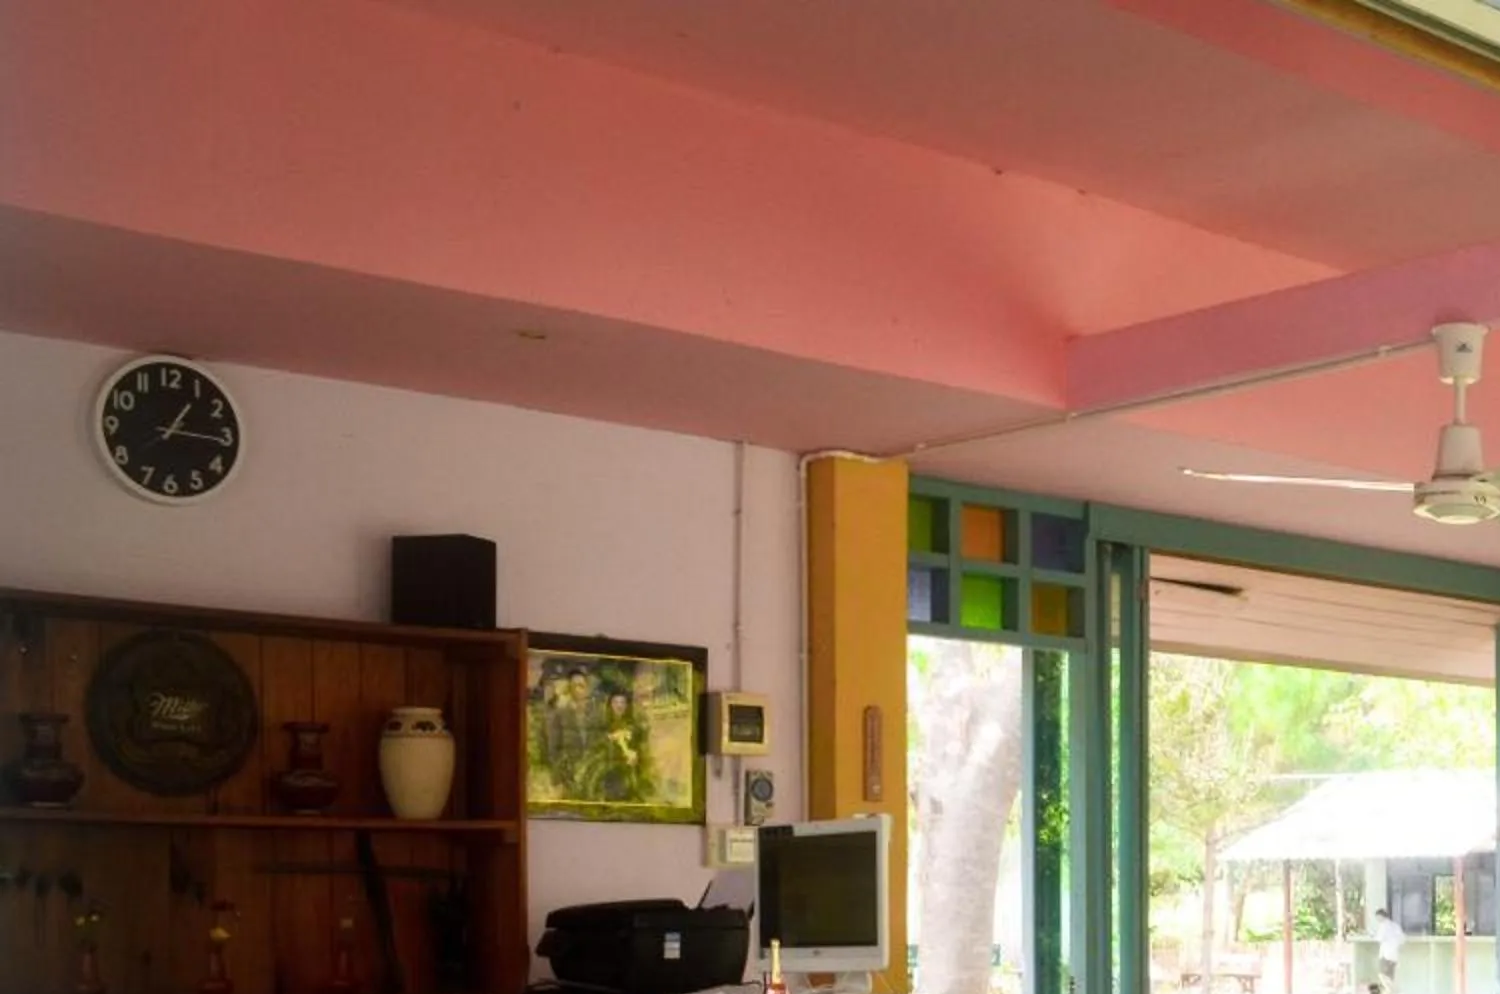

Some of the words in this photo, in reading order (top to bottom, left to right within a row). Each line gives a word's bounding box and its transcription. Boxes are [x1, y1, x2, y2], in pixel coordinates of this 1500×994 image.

[136, 372, 149, 393] 11
[160, 367, 182, 389] 12
[194, 379, 201, 399] 1
[112, 389, 135, 411] 10
[210, 399, 224, 418] 2
[105, 415, 120, 436] 9
[220, 427, 234, 447] 3
[115, 445, 129, 465] 8
[208, 455, 223, 475] 4
[140, 466, 156, 485] 7
[163, 473, 179, 494] 6
[190, 470, 204, 490] 5
